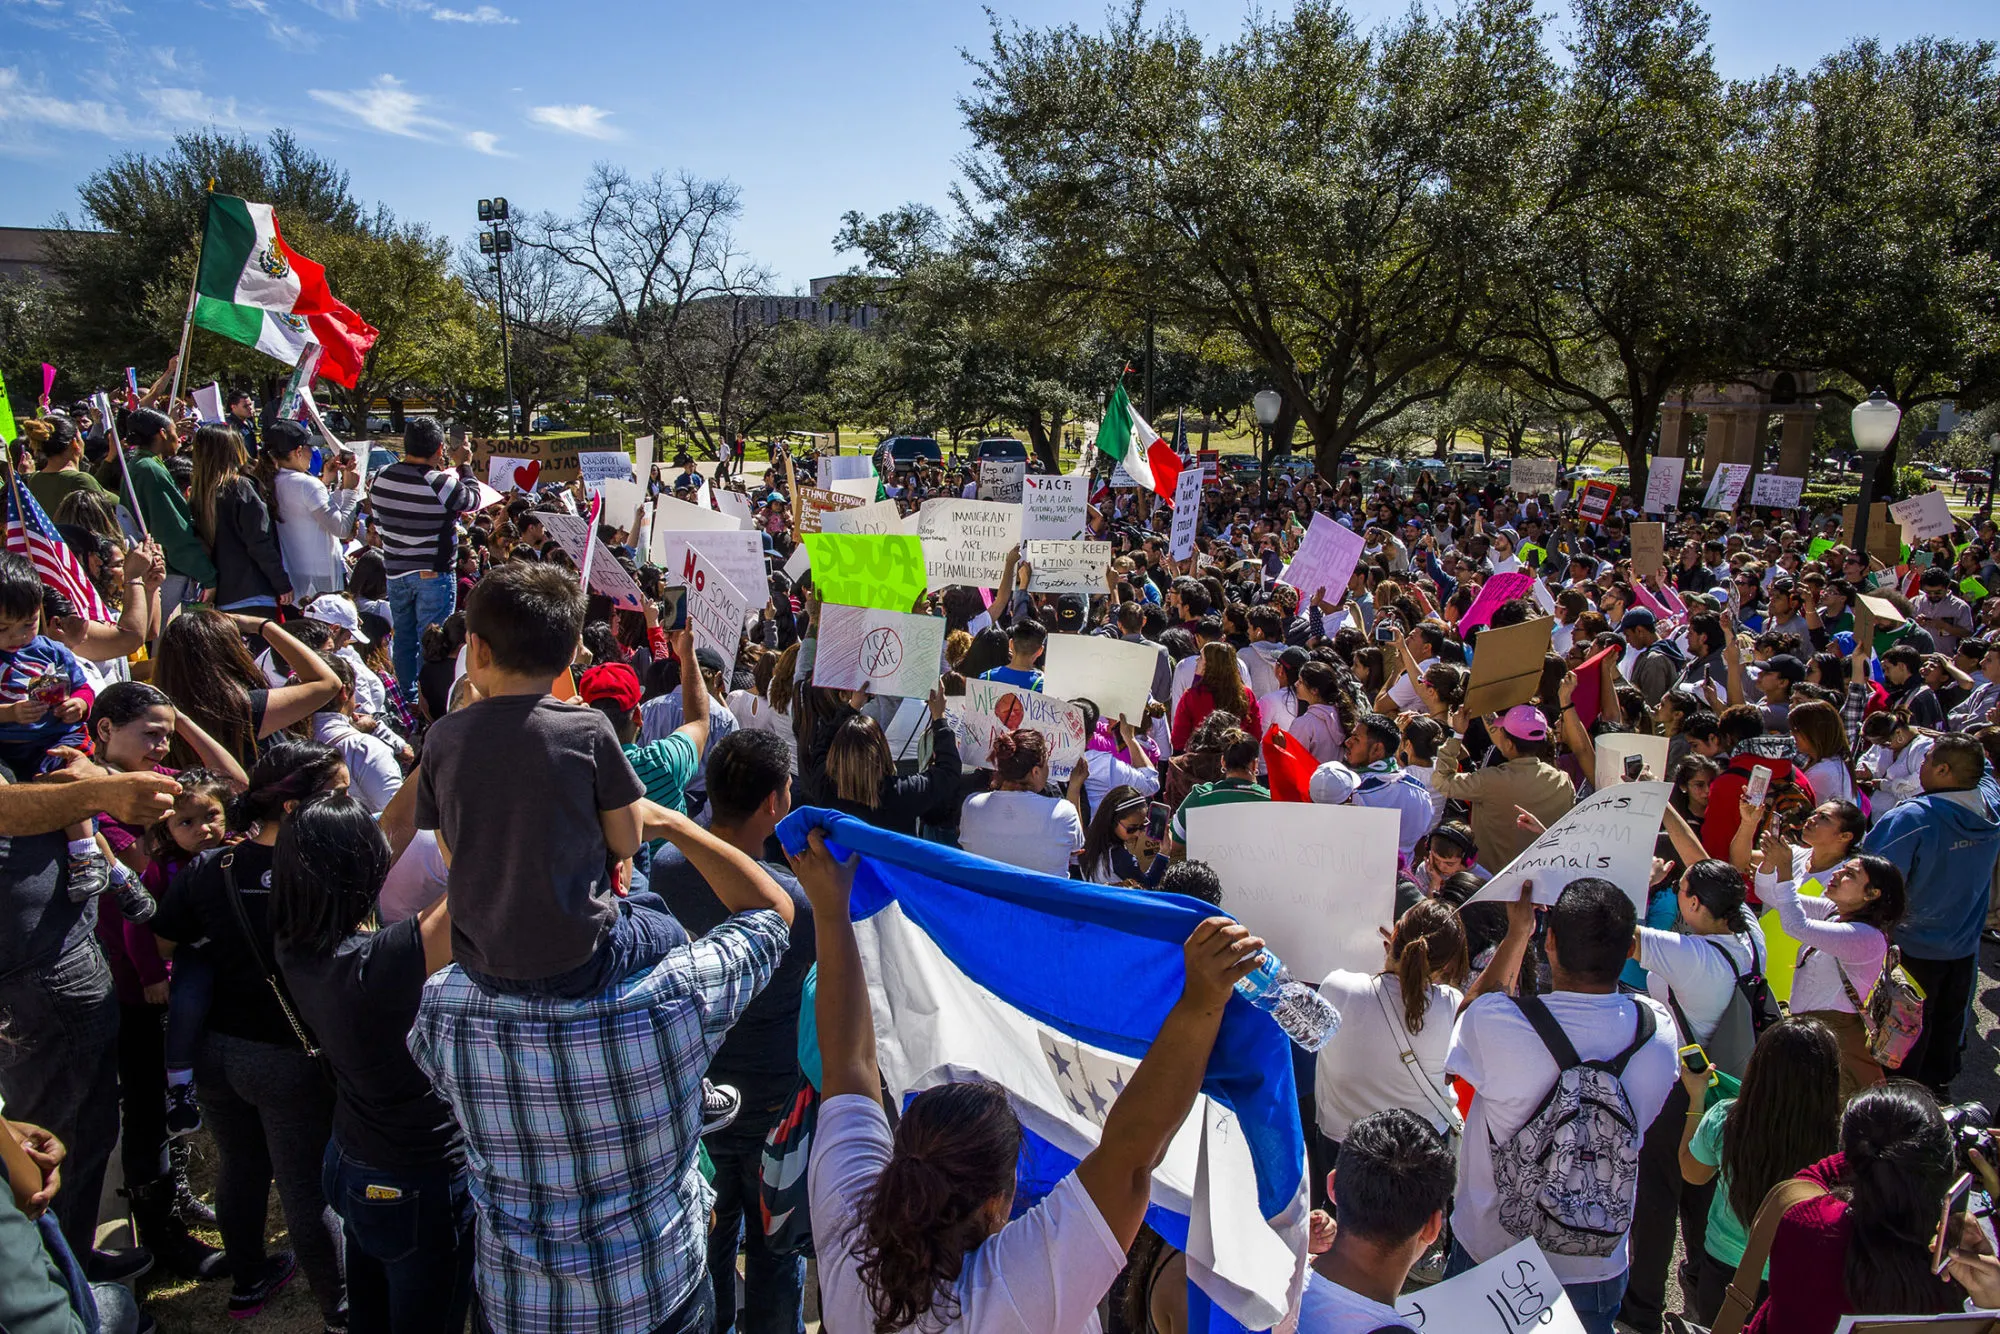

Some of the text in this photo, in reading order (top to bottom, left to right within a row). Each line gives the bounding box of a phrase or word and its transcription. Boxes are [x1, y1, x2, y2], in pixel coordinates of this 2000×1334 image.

[486, 440, 541, 453] SOMOS
[1039, 479, 1072, 491] FACT:
[1186, 475, 1194, 486] NO
[1647, 471, 1663, 502] FUCK
[992, 480, 1023, 496] TOGETHE
[800, 487, 829, 503] ETHNIC
[952, 511, 1012, 522] IMMIGRANT
[961, 524, 1006, 538] RIGHTS
[961, 540, 981, 550] ARE
[1031, 543, 1075, 554] LET'S
[1082, 543, 1109, 554] KEEP
[945, 549, 975, 561] CIVIL
[1033, 559, 1074, 570] LATINO
[709, 582, 740, 627] SOMOS
[867, 629, 894, 650] ICE
[971, 683, 998, 716] WE
[1500, 852, 1612, 877] riminals
